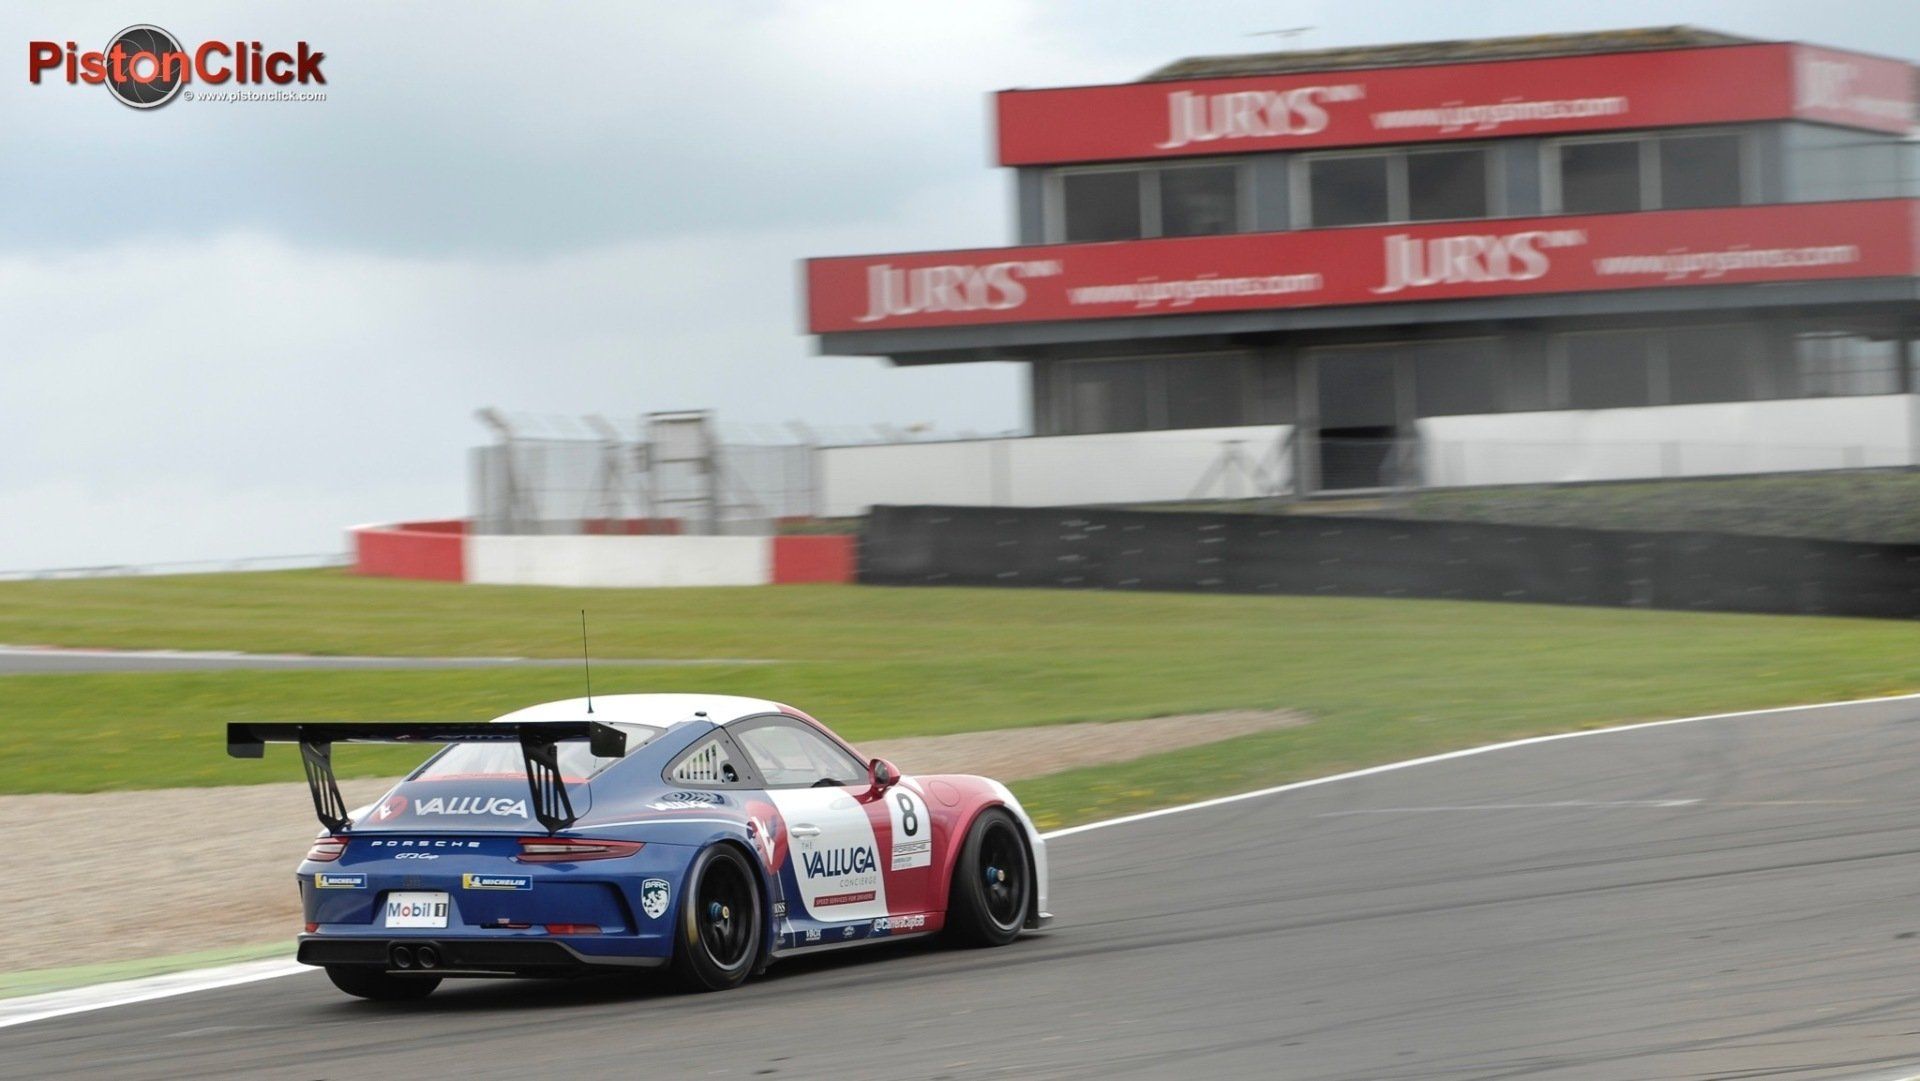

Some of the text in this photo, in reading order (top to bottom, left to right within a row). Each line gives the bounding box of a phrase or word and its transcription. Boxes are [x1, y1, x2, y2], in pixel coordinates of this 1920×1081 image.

[1155, 88, 1330, 149] JURYS
[1375, 231, 1551, 294] JURYS
[853, 262, 1028, 322] JURYS
[414, 797, 528, 819] VALLUGA
[896, 793, 918, 837] 8
[371, 840, 481, 848] PORSCHE
[803, 846, 876, 879] VALLUGA
[328, 877, 362, 885] MICHELIN
[481, 878, 527, 886] MICHELIN
[645, 882, 668, 890] BARC
[839, 876, 877, 888] CONCIERGE
[388, 902, 447, 918] Mobil 1
